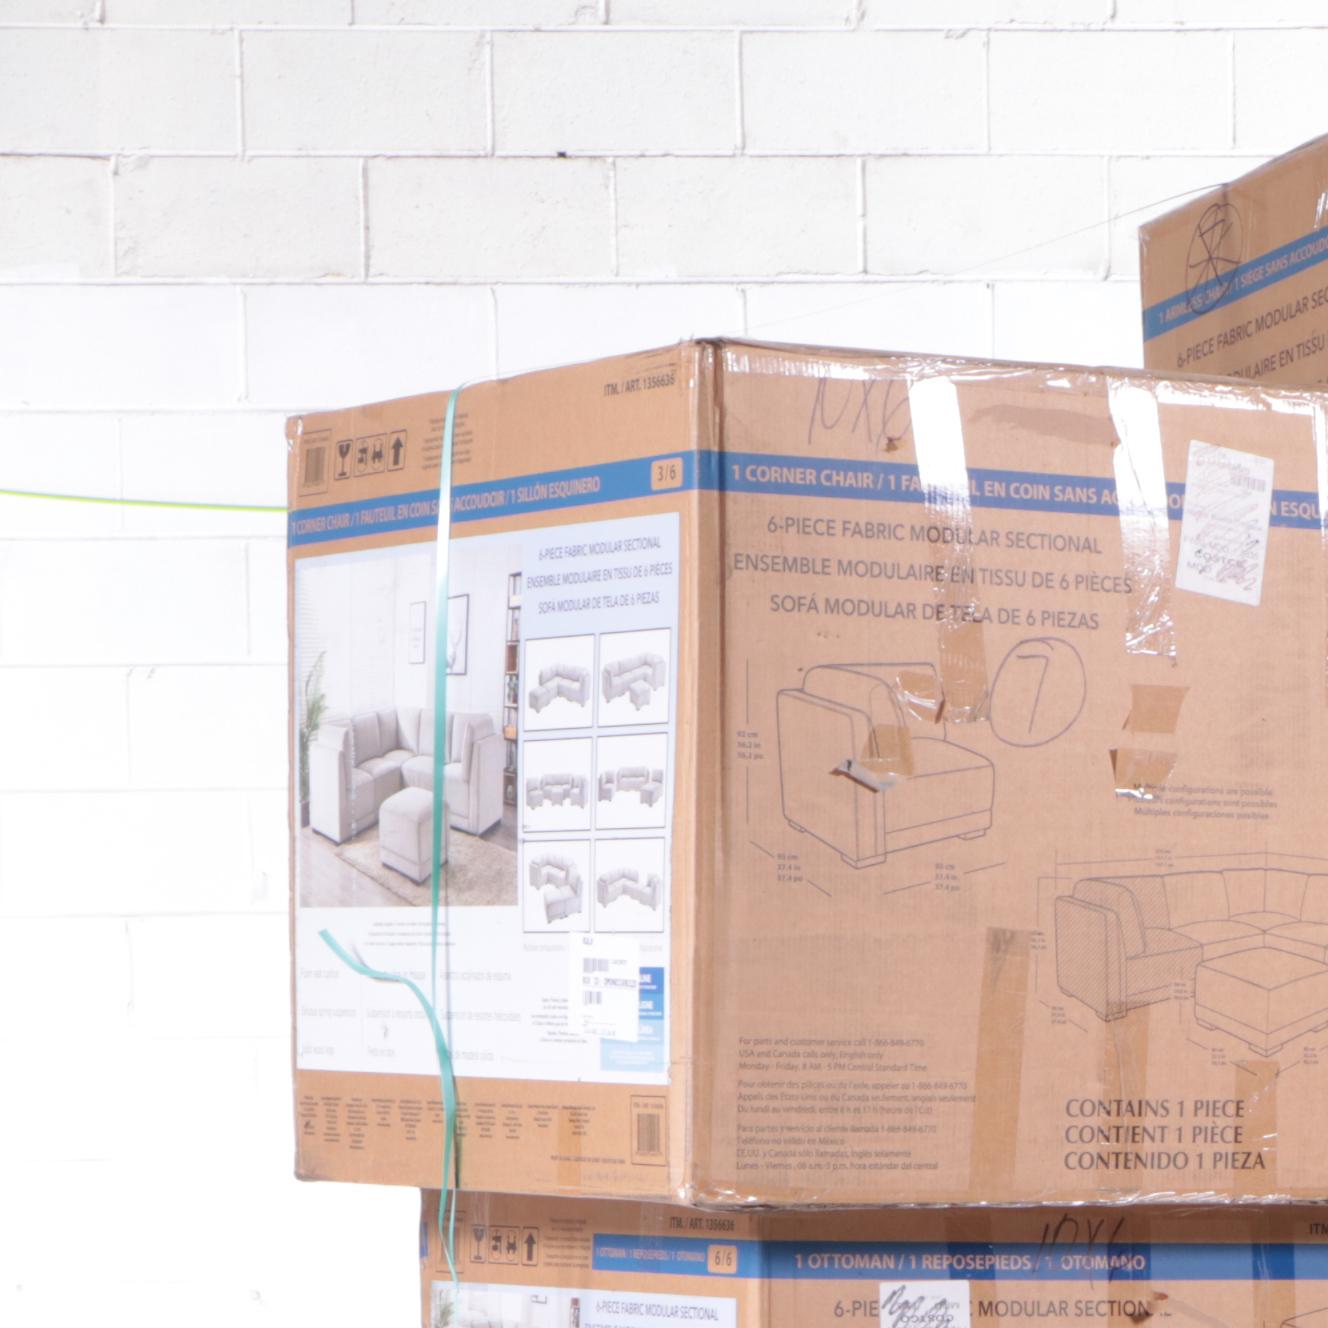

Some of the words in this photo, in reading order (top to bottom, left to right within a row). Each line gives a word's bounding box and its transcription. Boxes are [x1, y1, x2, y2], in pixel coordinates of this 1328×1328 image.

[1176, 336, 1213, 369] 6-PIECE
[1217, 319, 1252, 350] FABRIC
[1255, 295, 1308, 334] MODULAR
[658, 464, 676, 481] 3/6
[745, 464, 816, 485] CORNER
[820, 469, 873, 488] CHAIR
[984, 480, 1005, 497] EN
[1009, 482, 1049, 500] COIN
[1054, 485, 1101, 504] SANS
[767, 515, 835, 536] 6-PIECE
[842, 520, 904, 540] FABRIC
[910, 524, 999, 547] MODULAR
[1005, 531, 1101, 554] SECTIONAL
[734, 553, 831, 575] ENSEMBLE
[837, 559, 944, 582] MODULAIRE
[980, 568, 1025, 587] TISSU
[1031, 571, 1054, 589] DE
[1059, 573, 1069, 590] 6
[1075, 574, 1132, 594] PIÈCES
[770, 594, 819, 613] SOFÁ
[824, 597, 916, 619] MODULAR
[922, 603, 944, 620] DE
[997, 607, 1020, 625] DE
[1026, 609, 1035, 626] 6
[1041, 610, 1099, 629] PIEZAS
[1065, 1099, 1169, 1117] CONTAINS
[1193, 1100, 1244, 1117] PIECE
[1065, 1125, 1166, 1143] CONTIENT
[1192, 1121, 1242, 1143] PIÈCE
[1064, 1151, 1188, 1169] CONTENIDO
[1213, 1151, 1265, 1169] PIEZA
[714, 1251, 731, 1265] 6/6
[808, 1253, 894, 1269] OTTOMAN
[922, 1254, 1032, 1270] REPOSEPIEDS
[978, 1300, 1068, 1316] MODULAR
